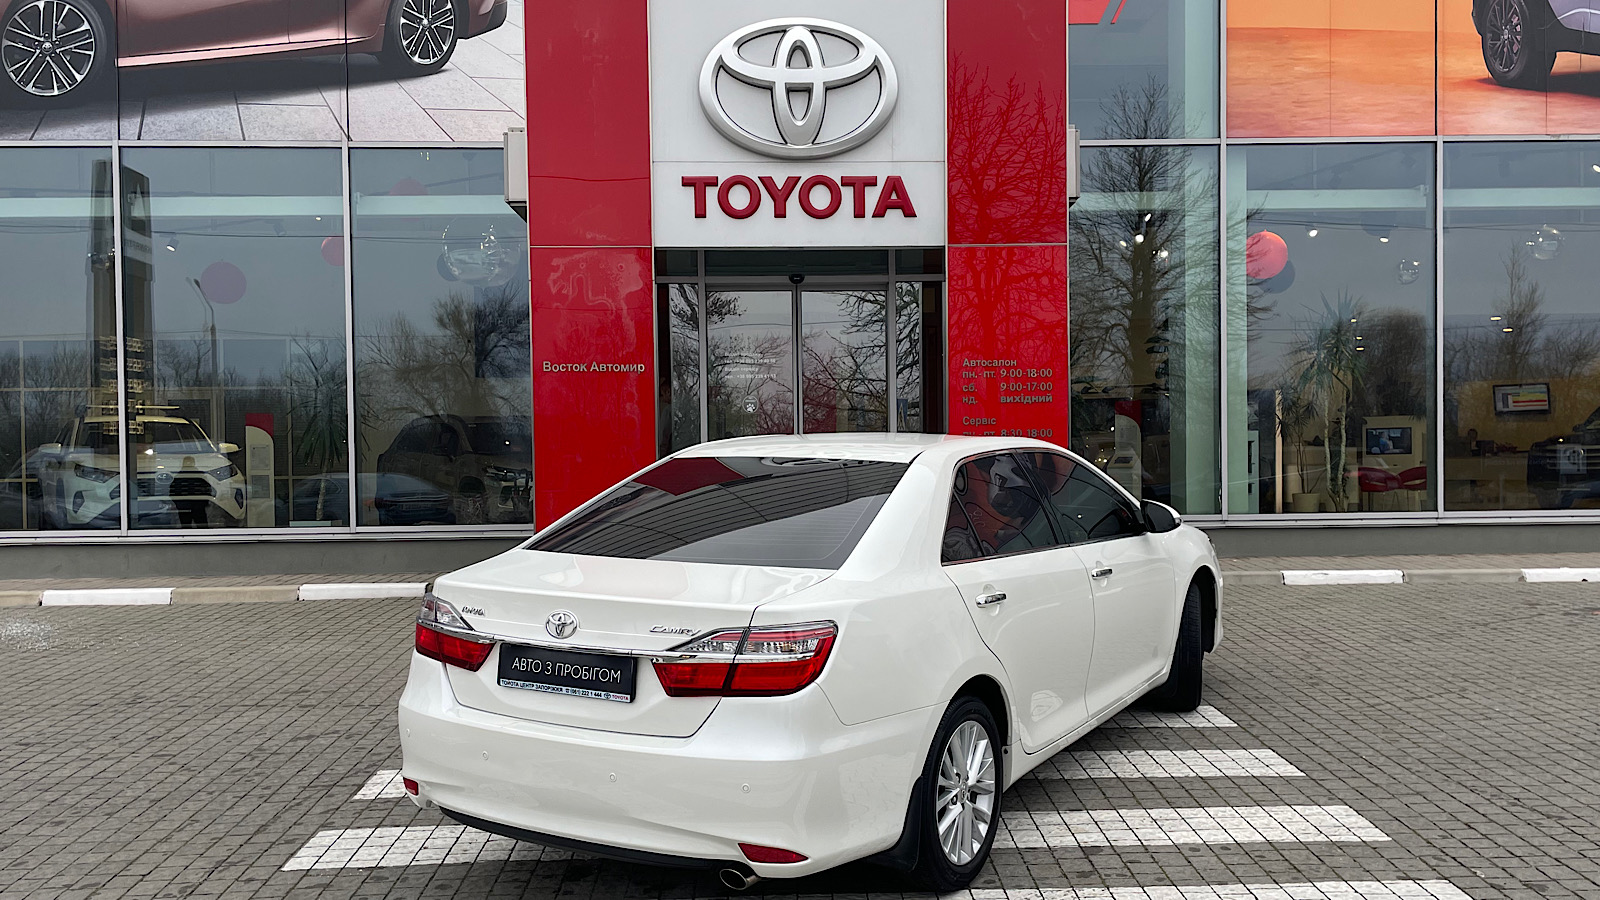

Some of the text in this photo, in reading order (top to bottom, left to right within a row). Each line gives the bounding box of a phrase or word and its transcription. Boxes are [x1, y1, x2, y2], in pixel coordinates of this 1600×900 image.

[682, 175, 917, 219] TOYOTA
[543, 361, 645, 374] Восток Автомир
[963, 358, 1016, 367] Автосалон
[962, 382, 1053, 392] сб. 9:00-17:00
[962, 393, 1053, 404] нд. вихідний
[962, 416, 997, 427] Сервіс
[649, 624, 702, 637] CAMRY
[511, 657, 542, 673] АВТО
[555, 662, 621, 683] ПРОБІГОМ
